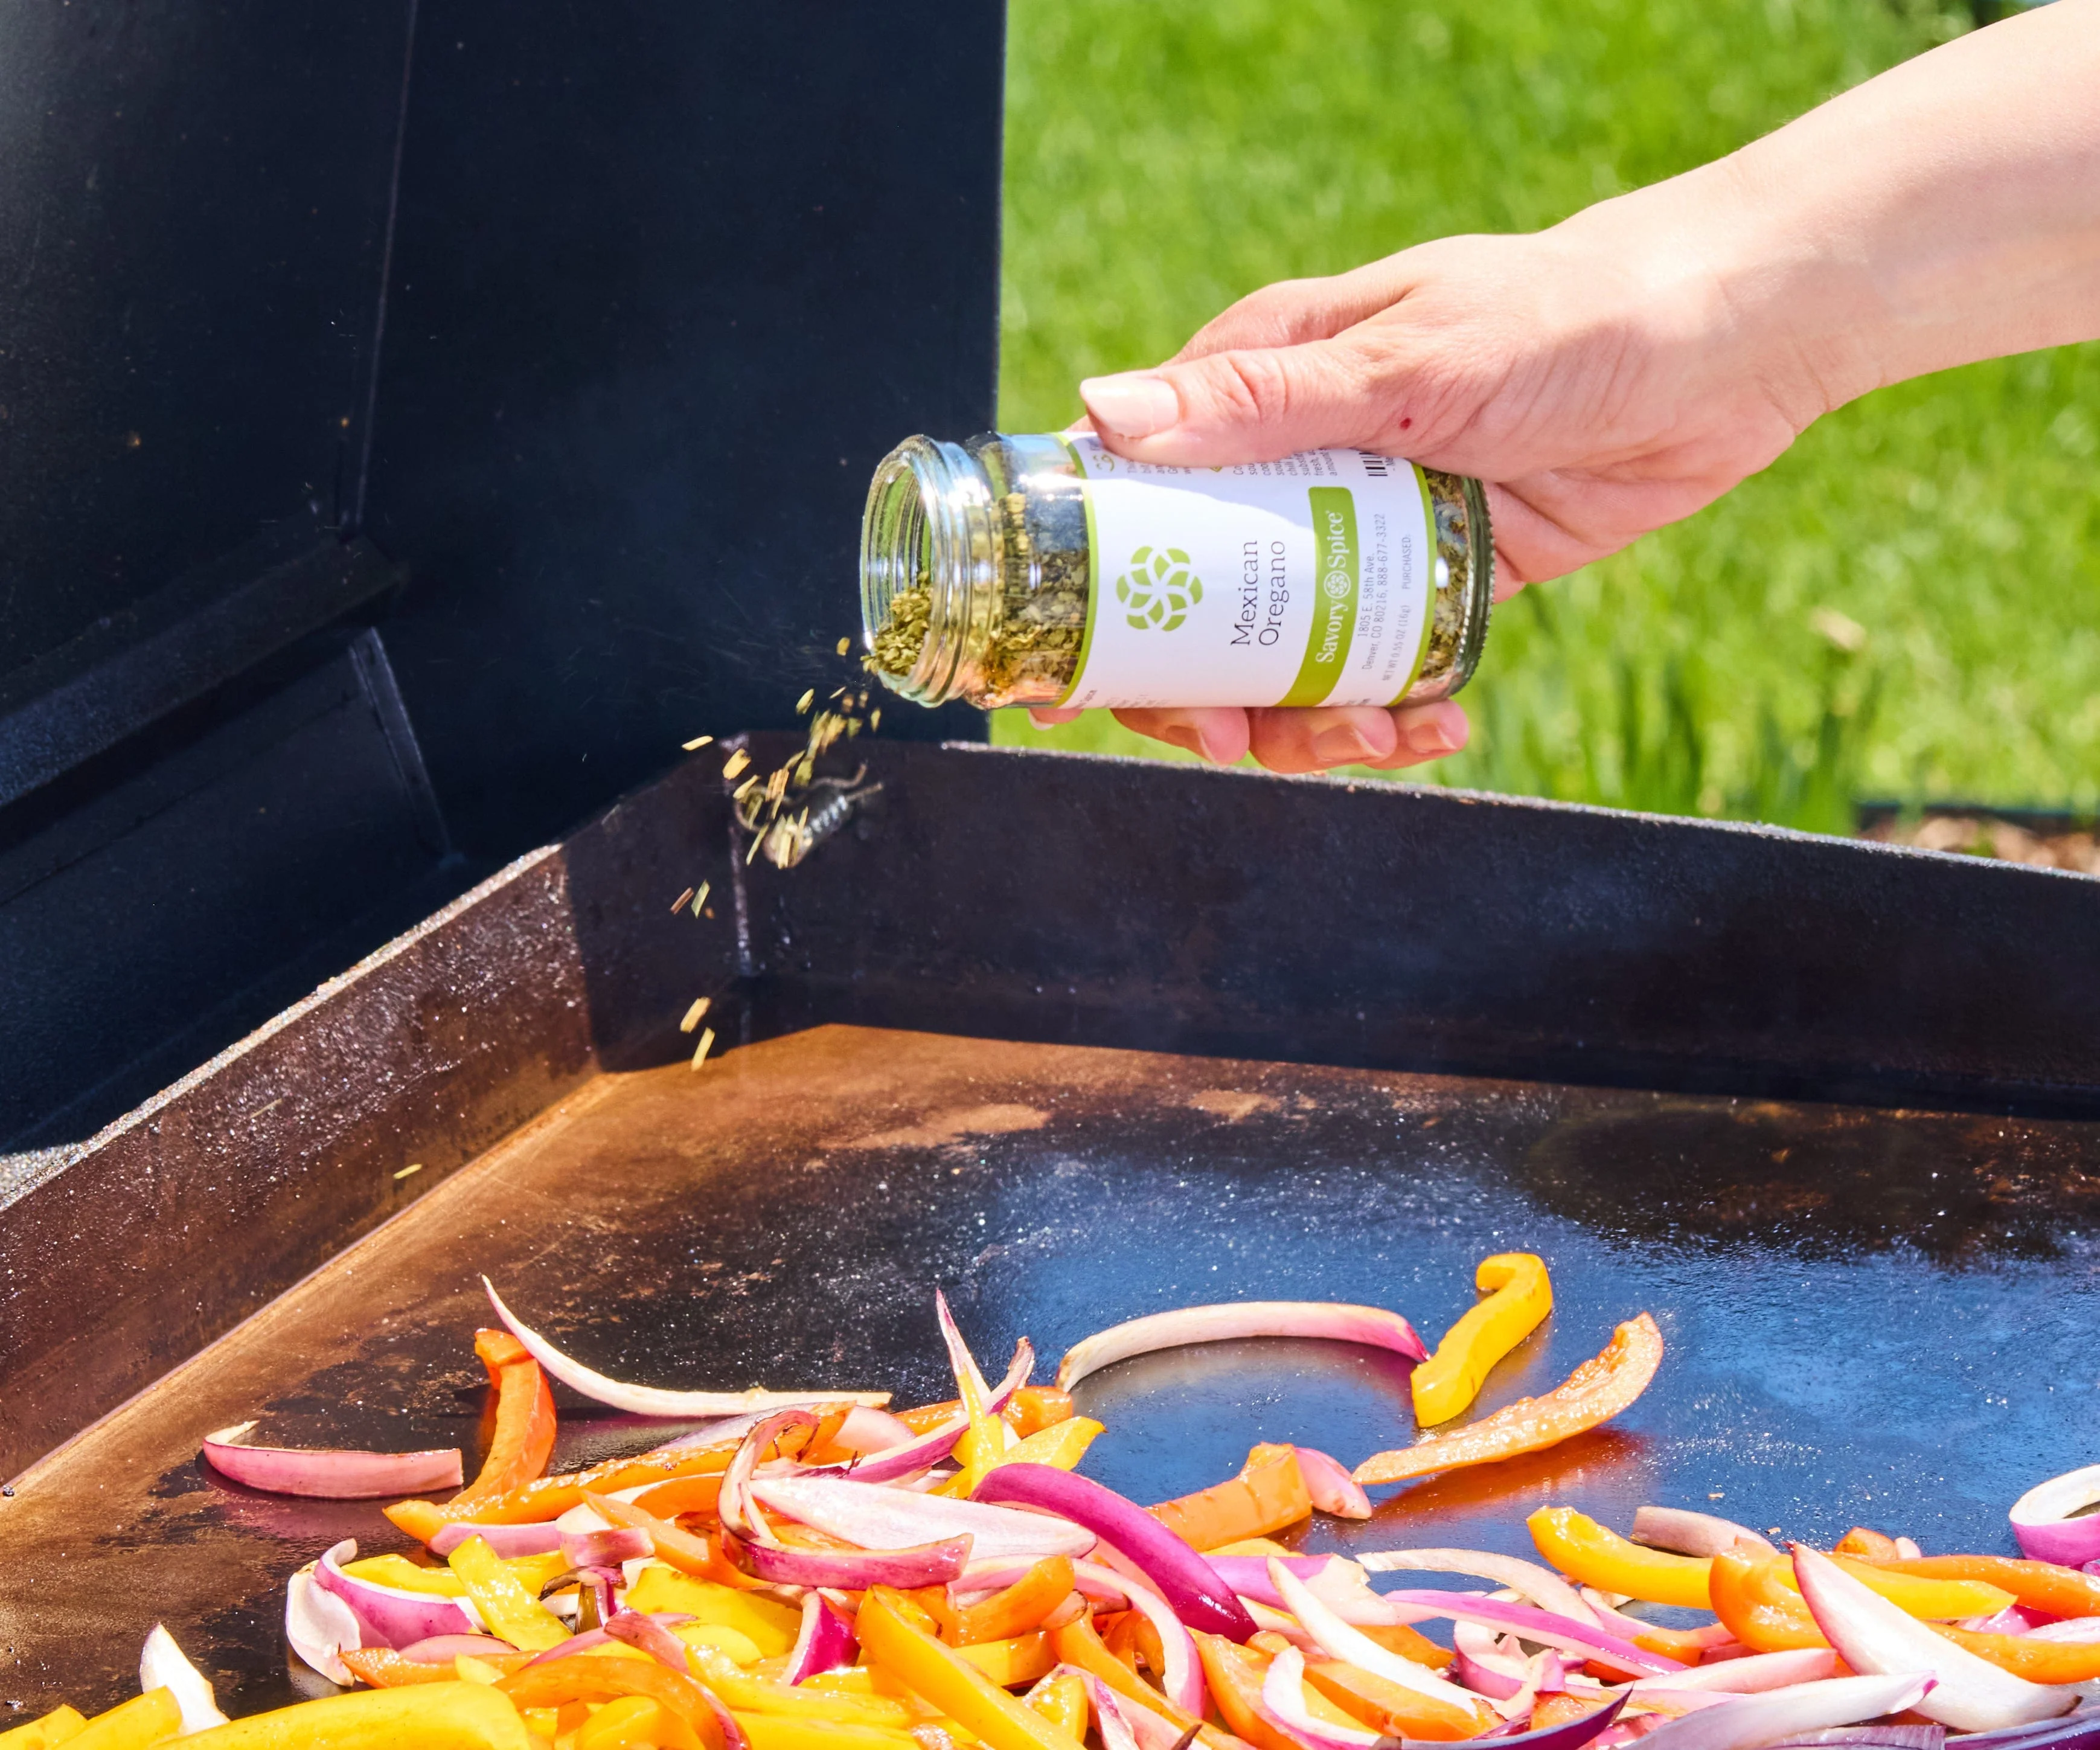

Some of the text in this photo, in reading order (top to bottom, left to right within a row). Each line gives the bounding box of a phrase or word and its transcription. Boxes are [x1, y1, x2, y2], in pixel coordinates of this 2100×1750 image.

[1230, 540, 1258, 646] Mexican
[1258, 541, 1290, 646] Oregano
[1315, 512, 1350, 663] Savory Spice
[1362, 513, 1388, 670] Denver, CO 80216, 888-677-3322
[1363, 577, 1374, 600] 58th
[1364, 553, 1375, 574] Ave.
[1401, 534, 1412, 590] PURCHASED:
[1357, 615, 1371, 637] 1805
